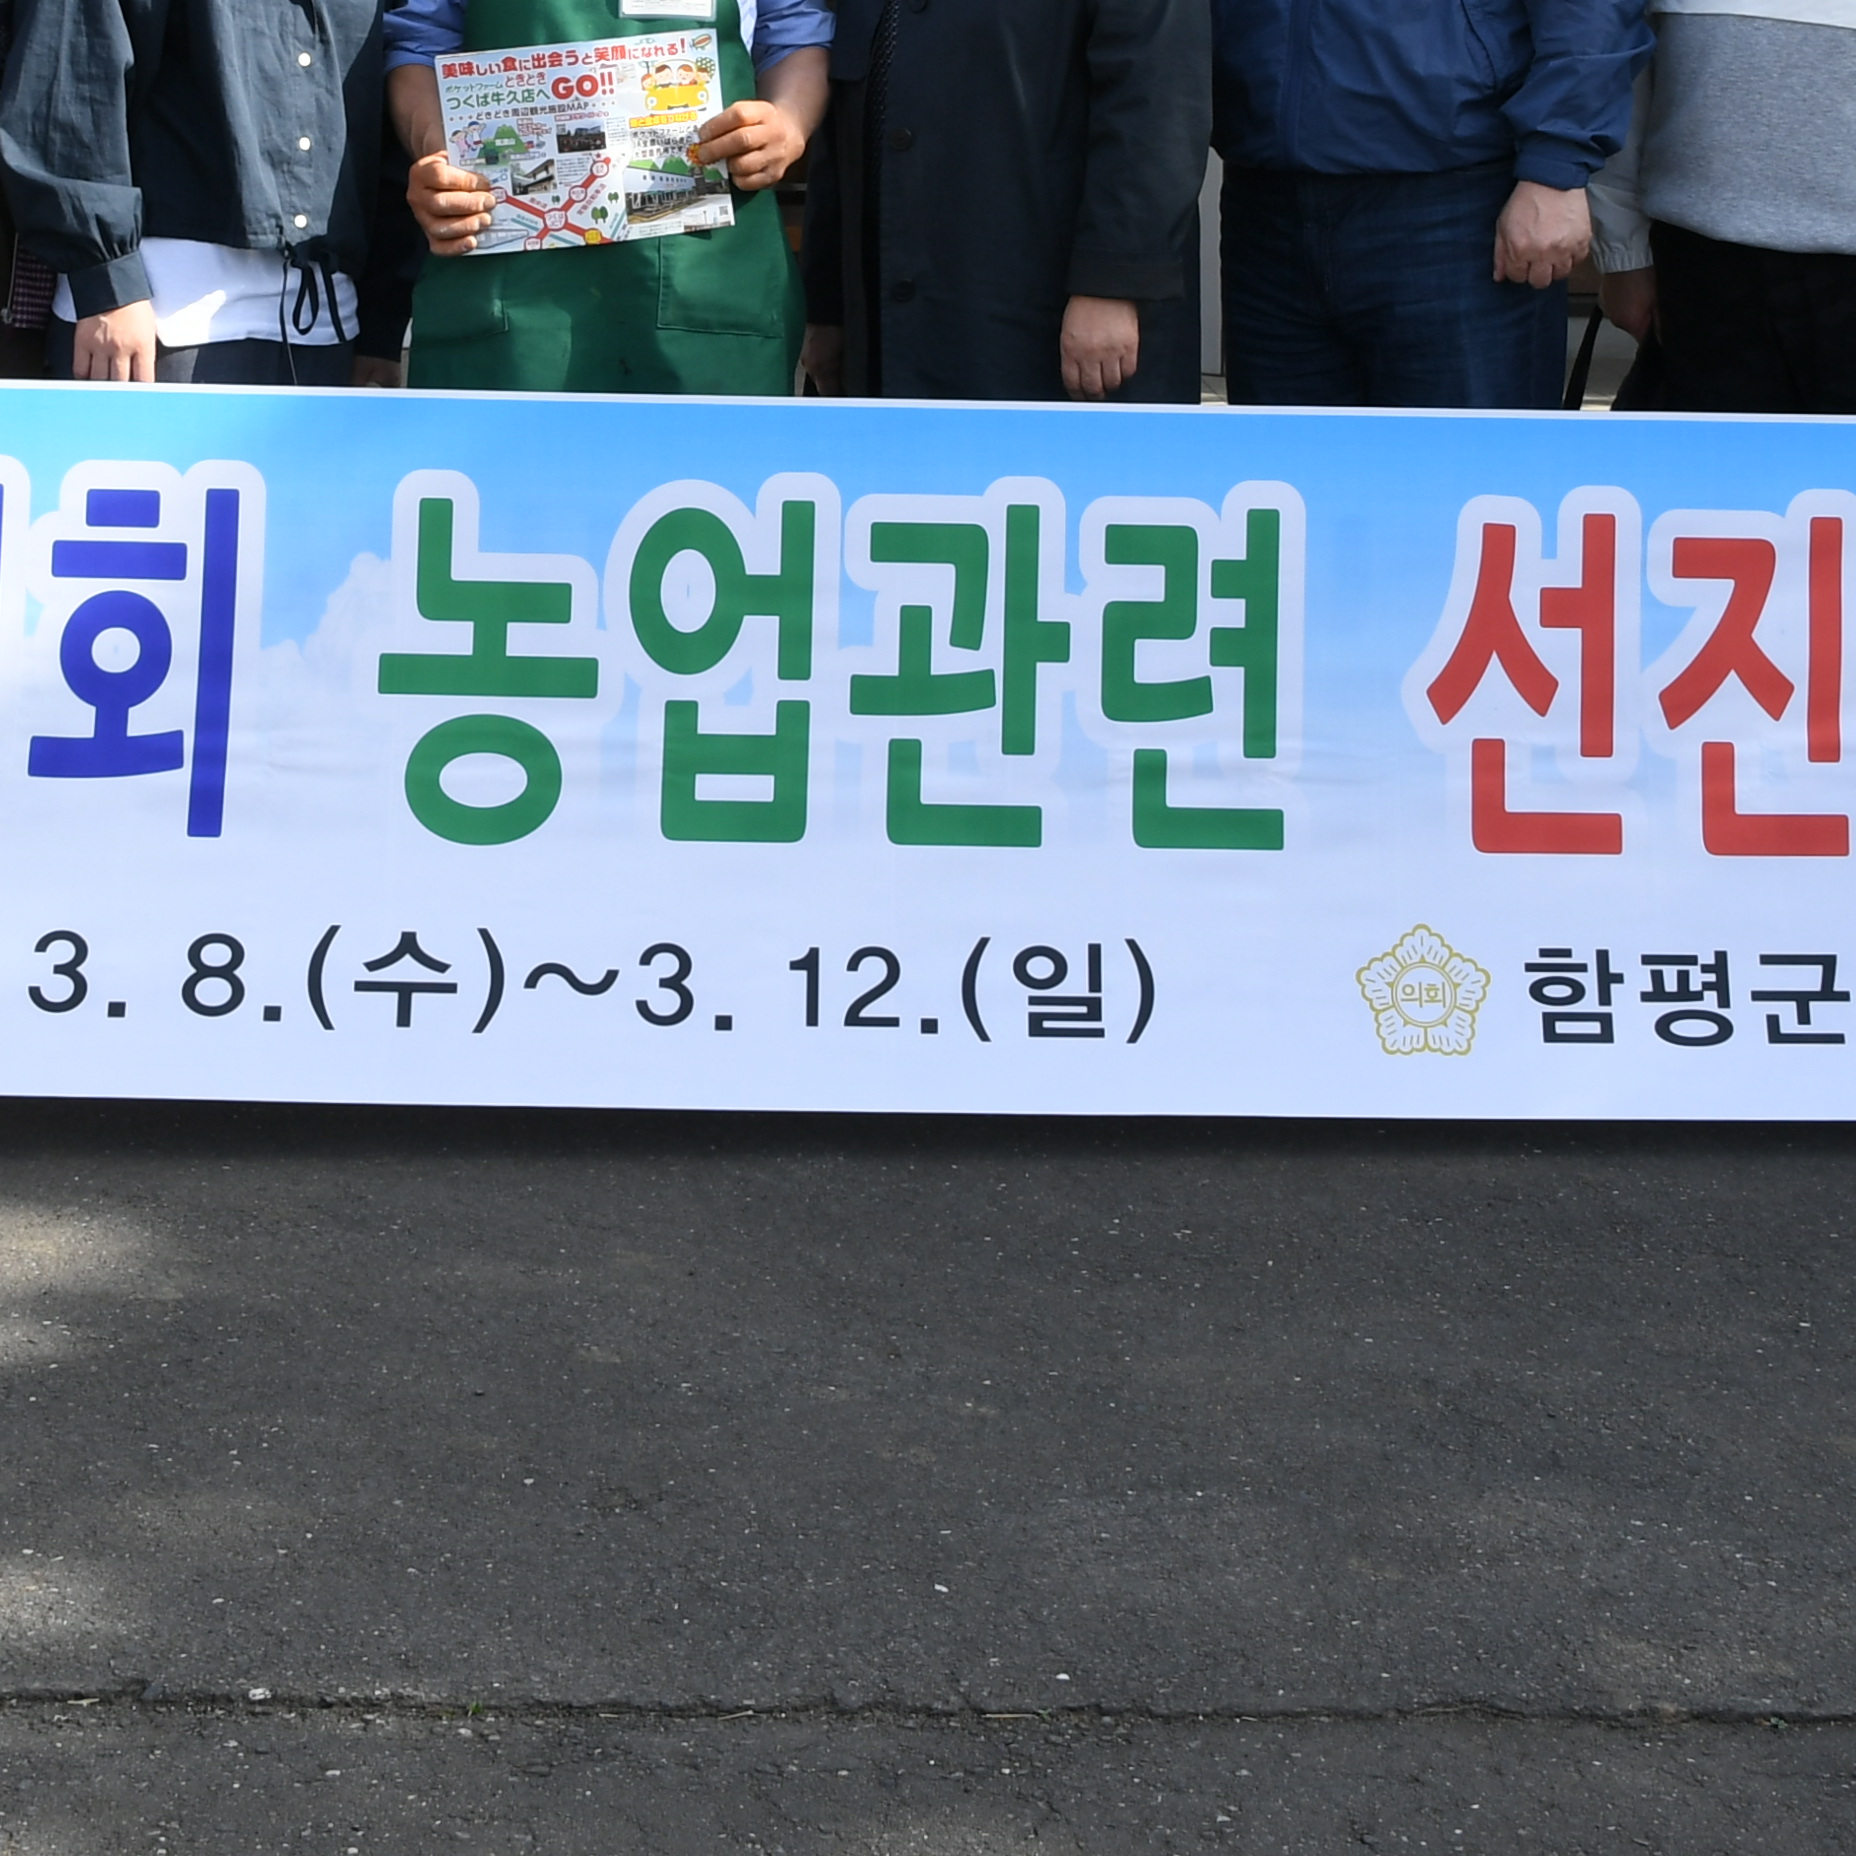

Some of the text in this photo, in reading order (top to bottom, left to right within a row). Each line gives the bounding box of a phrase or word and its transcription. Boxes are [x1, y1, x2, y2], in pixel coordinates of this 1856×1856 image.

[446, 71, 615, 111] つくば牛久店へ GO!!
[378, 496, 1285, 850] 농업관련
[28, 930, 128, 1018] 3.
[789, 936, 1156, 1043] 12.(일)
[1399, 981, 1447, 1009] 의회
